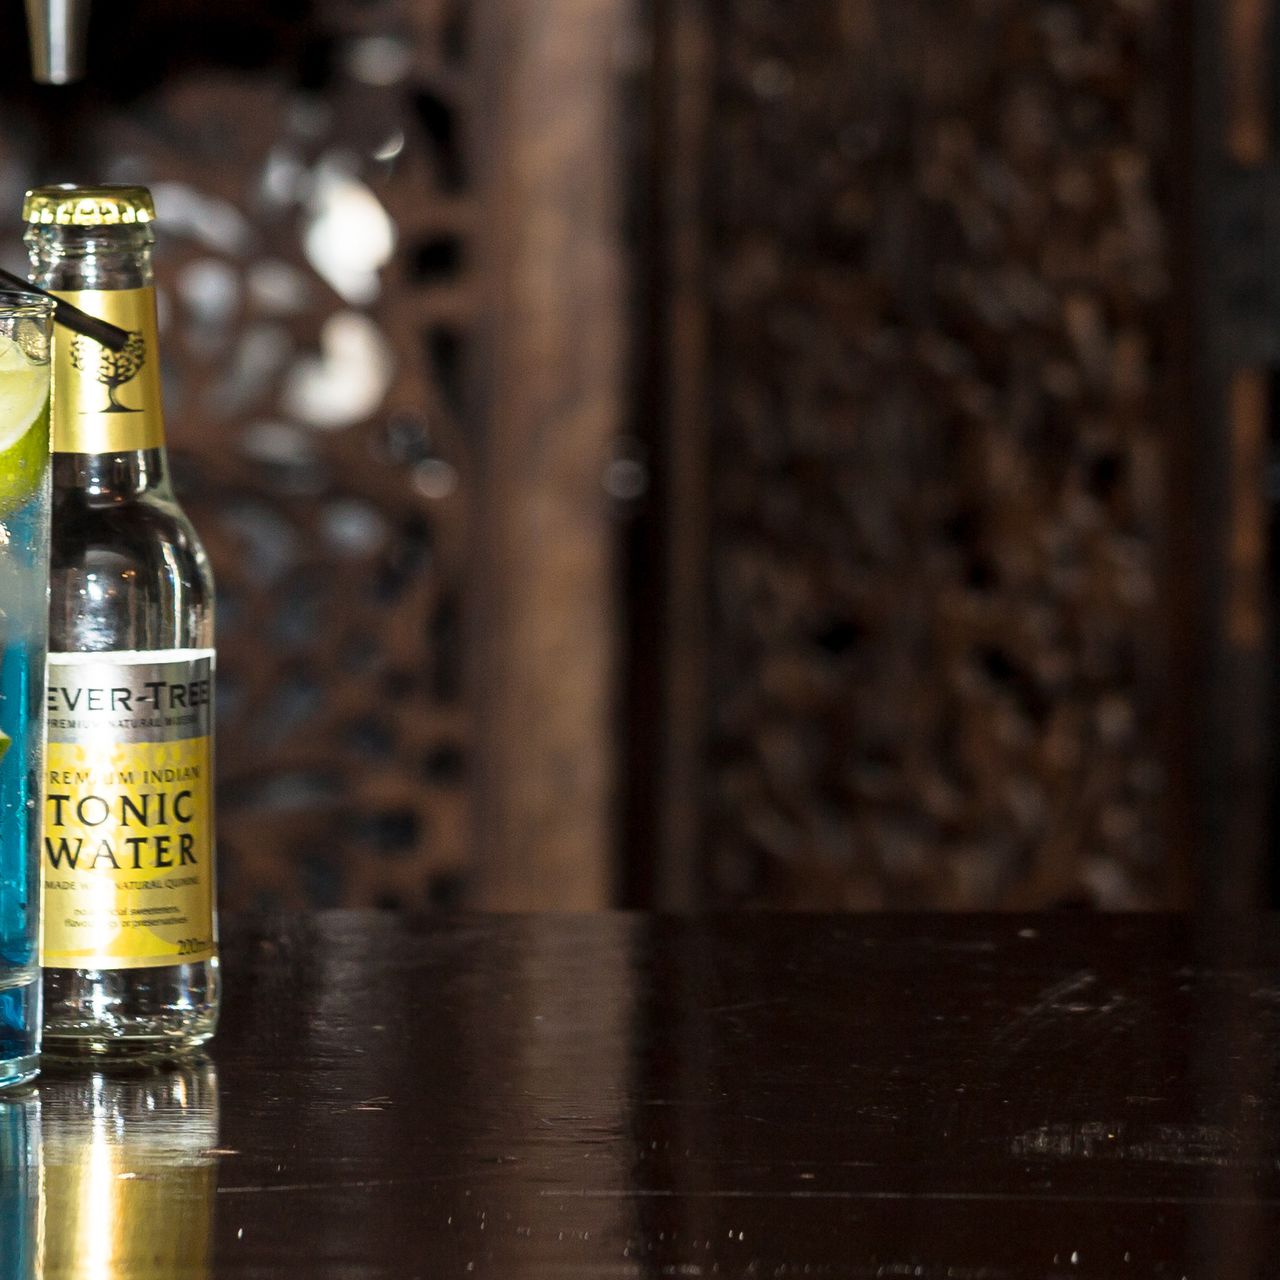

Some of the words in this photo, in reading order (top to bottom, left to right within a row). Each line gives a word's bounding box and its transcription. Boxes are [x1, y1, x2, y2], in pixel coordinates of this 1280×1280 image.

[48, 680, 210, 712] EVER-TREE
[142, 765, 201, 785] INDIAN
[47, 789, 194, 828] TONIC
[44, 832, 199, 871] WATER
